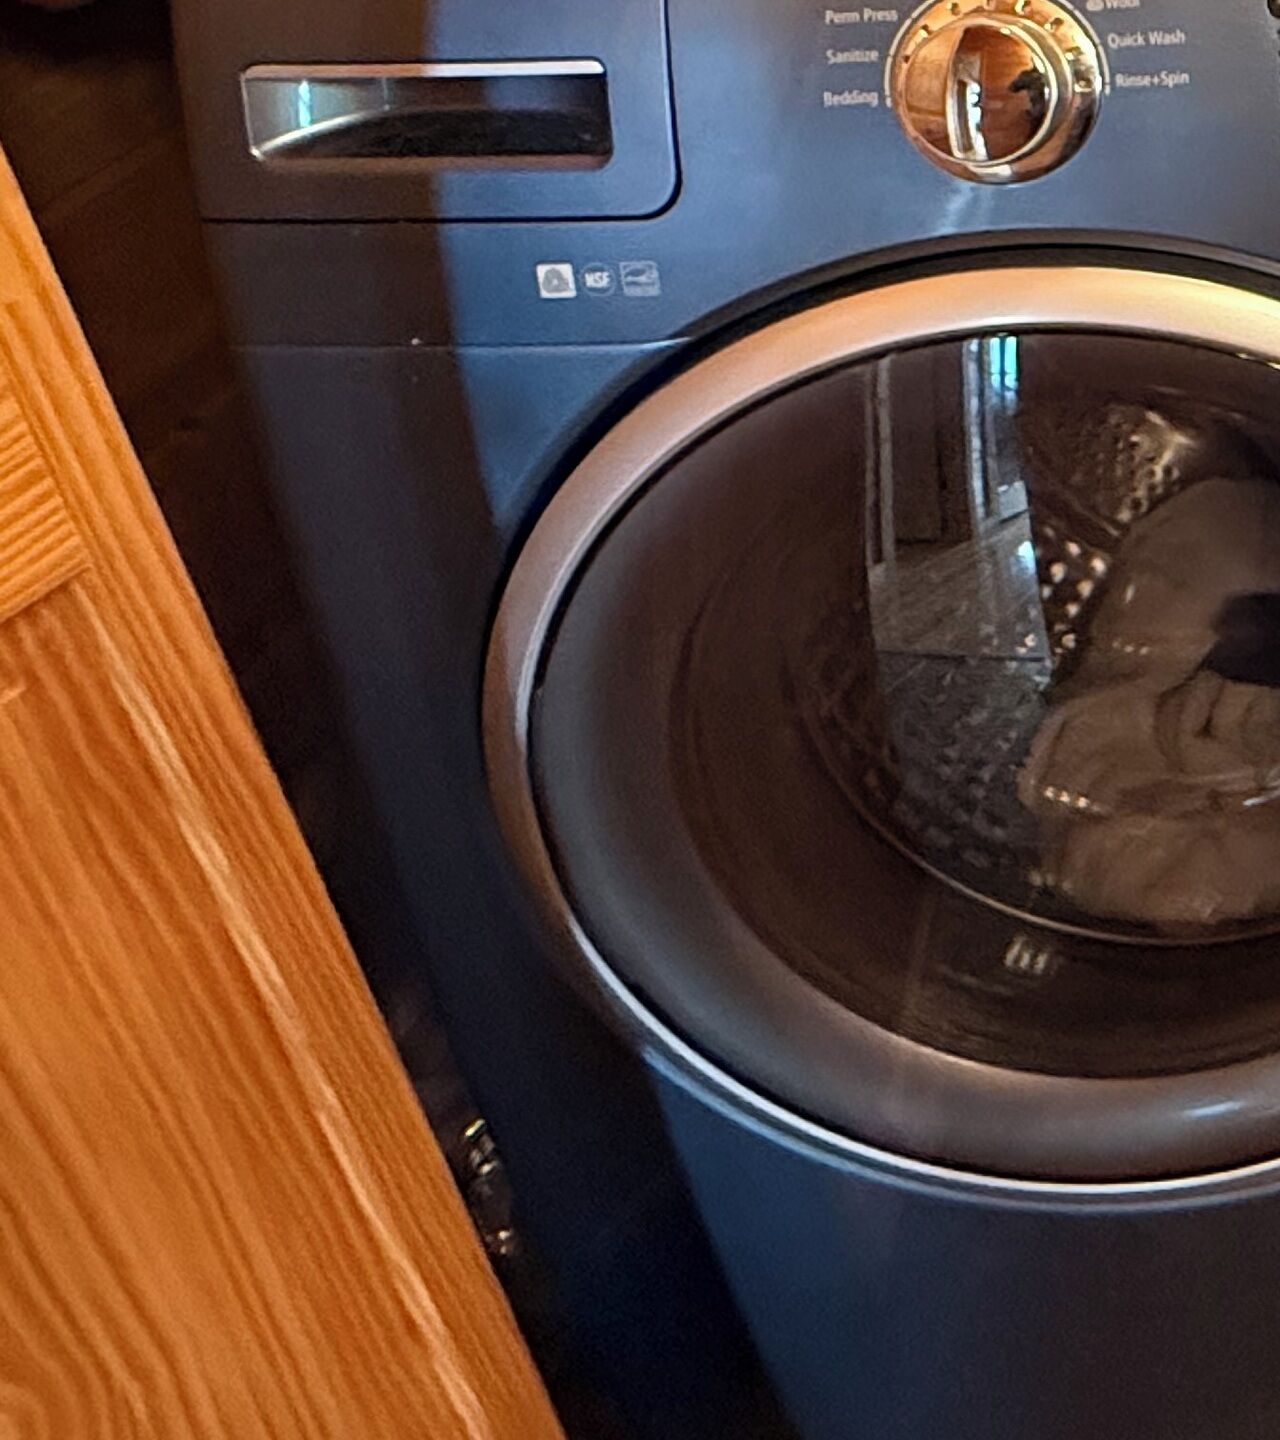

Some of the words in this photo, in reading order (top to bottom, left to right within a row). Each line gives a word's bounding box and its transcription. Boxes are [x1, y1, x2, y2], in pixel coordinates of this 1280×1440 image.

[824, 9, 861, 25] Perm
[863, 7, 899, 23] Press
[1107, 32, 1146, 49] Quick
[1148, 29, 1186, 46] Wash
[825, 48, 880, 64] Sanitize
[823, 90, 879, 108] Bedding
